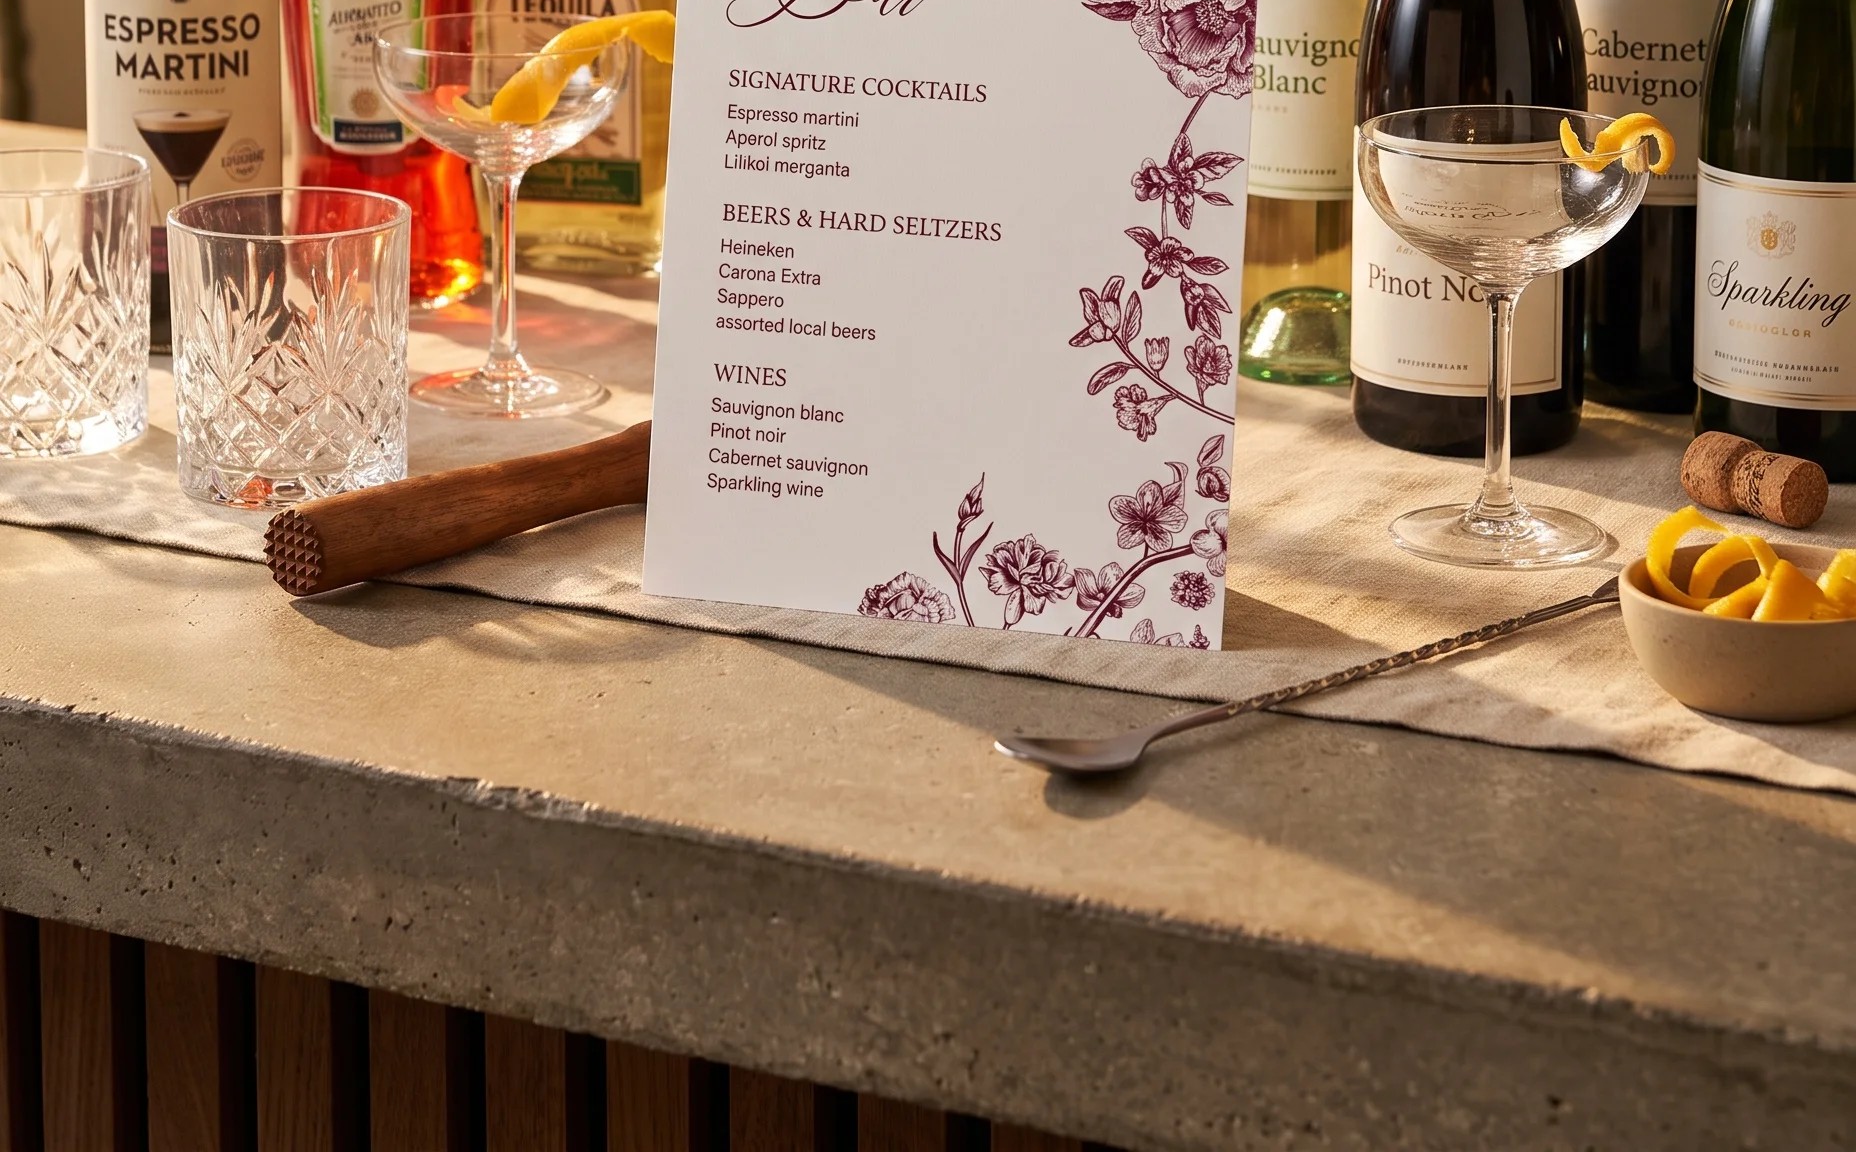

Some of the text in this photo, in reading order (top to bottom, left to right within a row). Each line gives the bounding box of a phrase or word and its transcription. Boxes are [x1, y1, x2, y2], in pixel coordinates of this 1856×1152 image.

[105, 13, 260, 45] ESPRESSO
[1254, 32, 1360, 67] auvigno
[1583, 28, 1707, 62] Cabernet
[116, 49, 249, 81] MARTINI
[728, 68, 987, 103] SIGNATURE COCKTAILS
[1587, 70, 1703, 106] auvigno
[727, 103, 860, 128] Espresso martini
[724, 128, 827, 153] Aperol spritz
[724, 153, 850, 179] Lilikoi merganta
[722, 203, 1002, 242] BEERS & HARD SELTZERS
[720, 237, 795, 259] Heineken
[718, 262, 821, 286] Carona Extra
[1368, 262, 1485, 303] Pinot No
[716, 287, 785, 310] Sappero
[1707, 259, 1851, 328] Sparkling
[715, 315, 876, 341] assorted local beers
[713, 362, 787, 387] WINES
[711, 396, 845, 424] Sauvignon blanc
[710, 422, 787, 444] Pinot noir
[708, 447, 869, 478] Cabernet sauvignon
[706, 472, 824, 499] Sparkling wine
